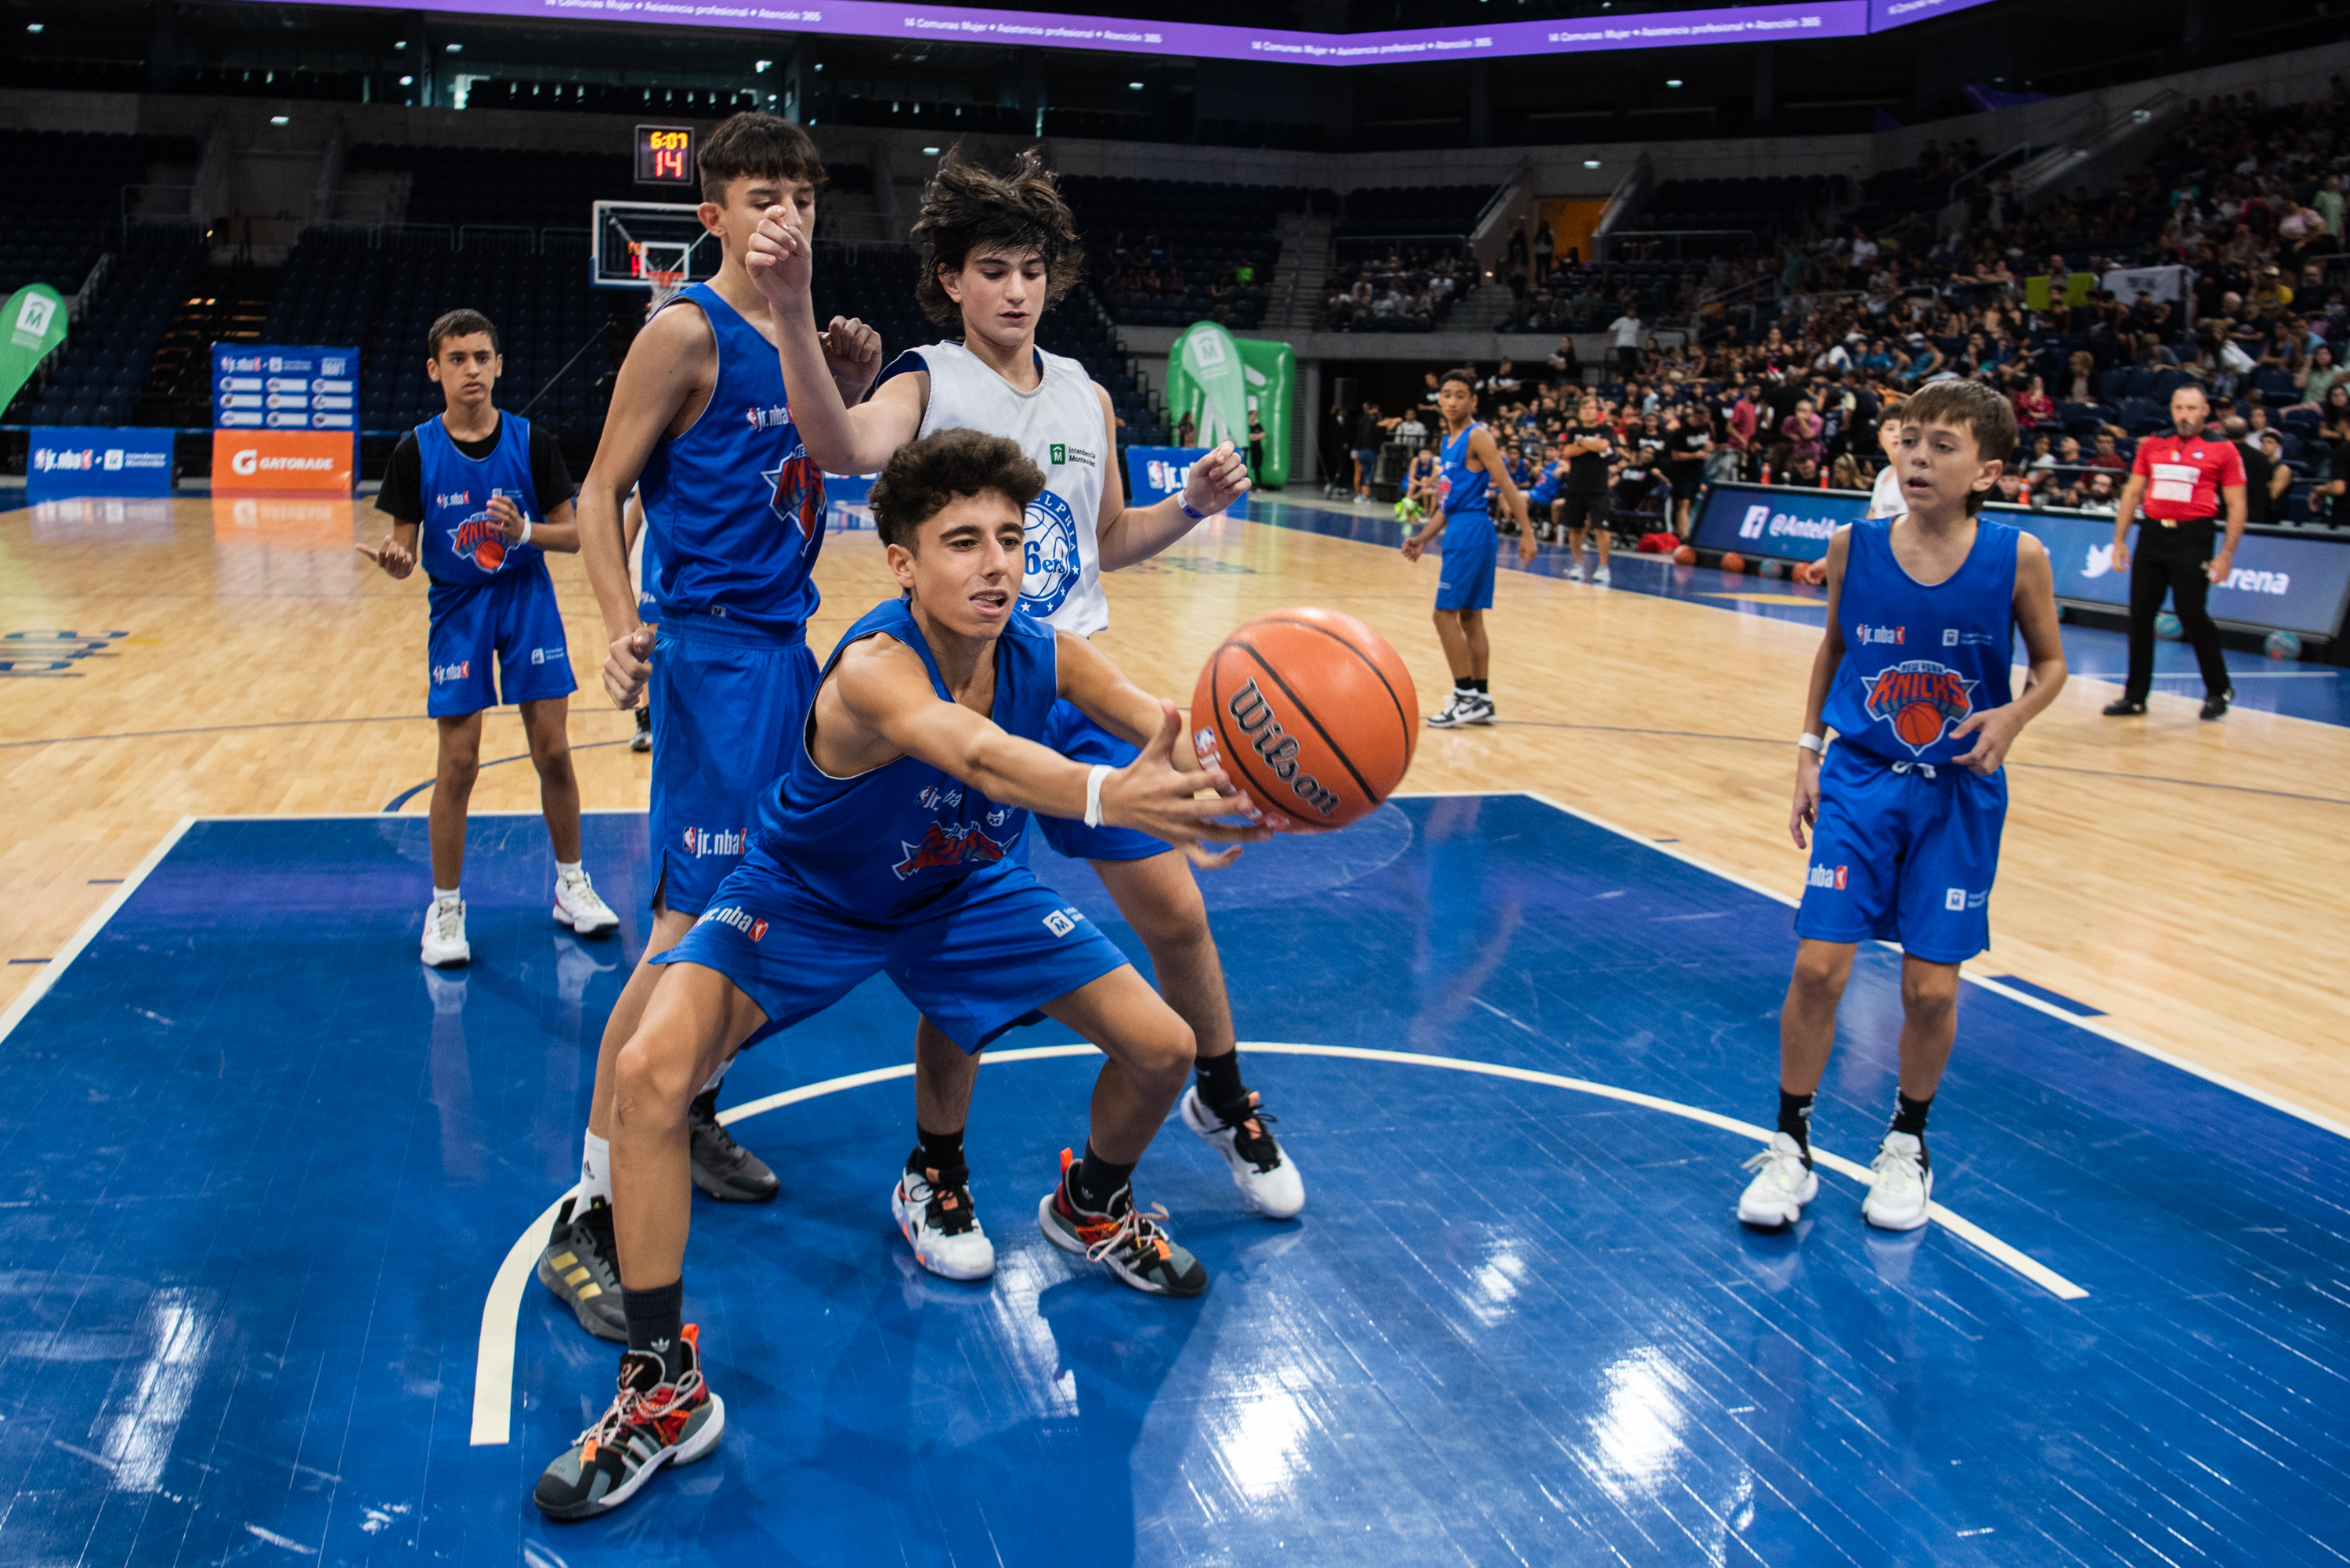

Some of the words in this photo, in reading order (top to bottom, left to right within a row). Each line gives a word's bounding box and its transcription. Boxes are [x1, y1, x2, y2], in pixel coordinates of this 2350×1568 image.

[1044, 27, 1094, 38] profesional
[649, 131, 689, 150] 6:07
[655, 150, 683, 179] 14
[258, 457, 334, 470] GATORADE
[2217, 567, 2290, 595] rena
[1861, 623, 1895, 645] jr.nba
[1867, 670, 1970, 709] KNICKS
[1226, 674, 1342, 816] Wilson
[695, 827, 740, 859] jr.nba
